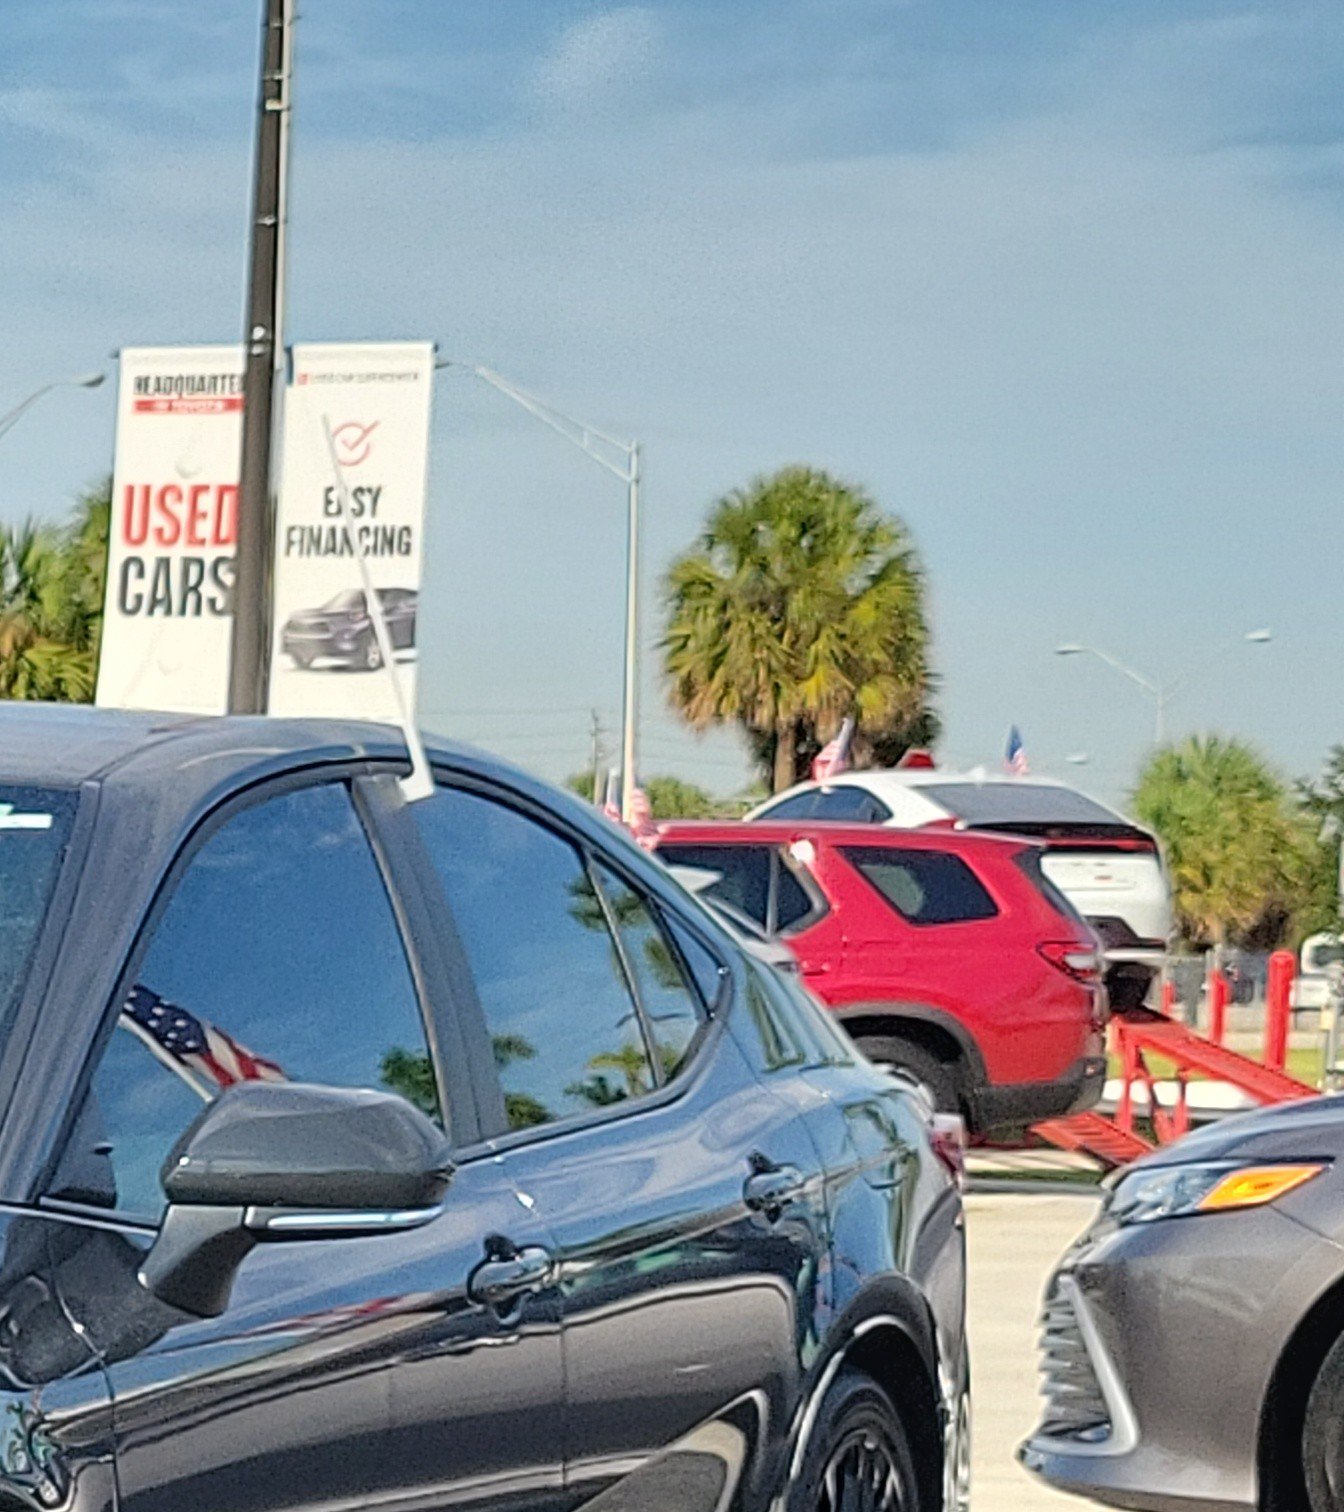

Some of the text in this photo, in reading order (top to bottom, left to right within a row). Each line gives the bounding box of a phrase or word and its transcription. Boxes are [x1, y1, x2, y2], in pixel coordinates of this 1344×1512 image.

[123, 484, 239, 547] USED
[285, 524, 412, 557] FINANCING
[118, 556, 237, 616] CARS
